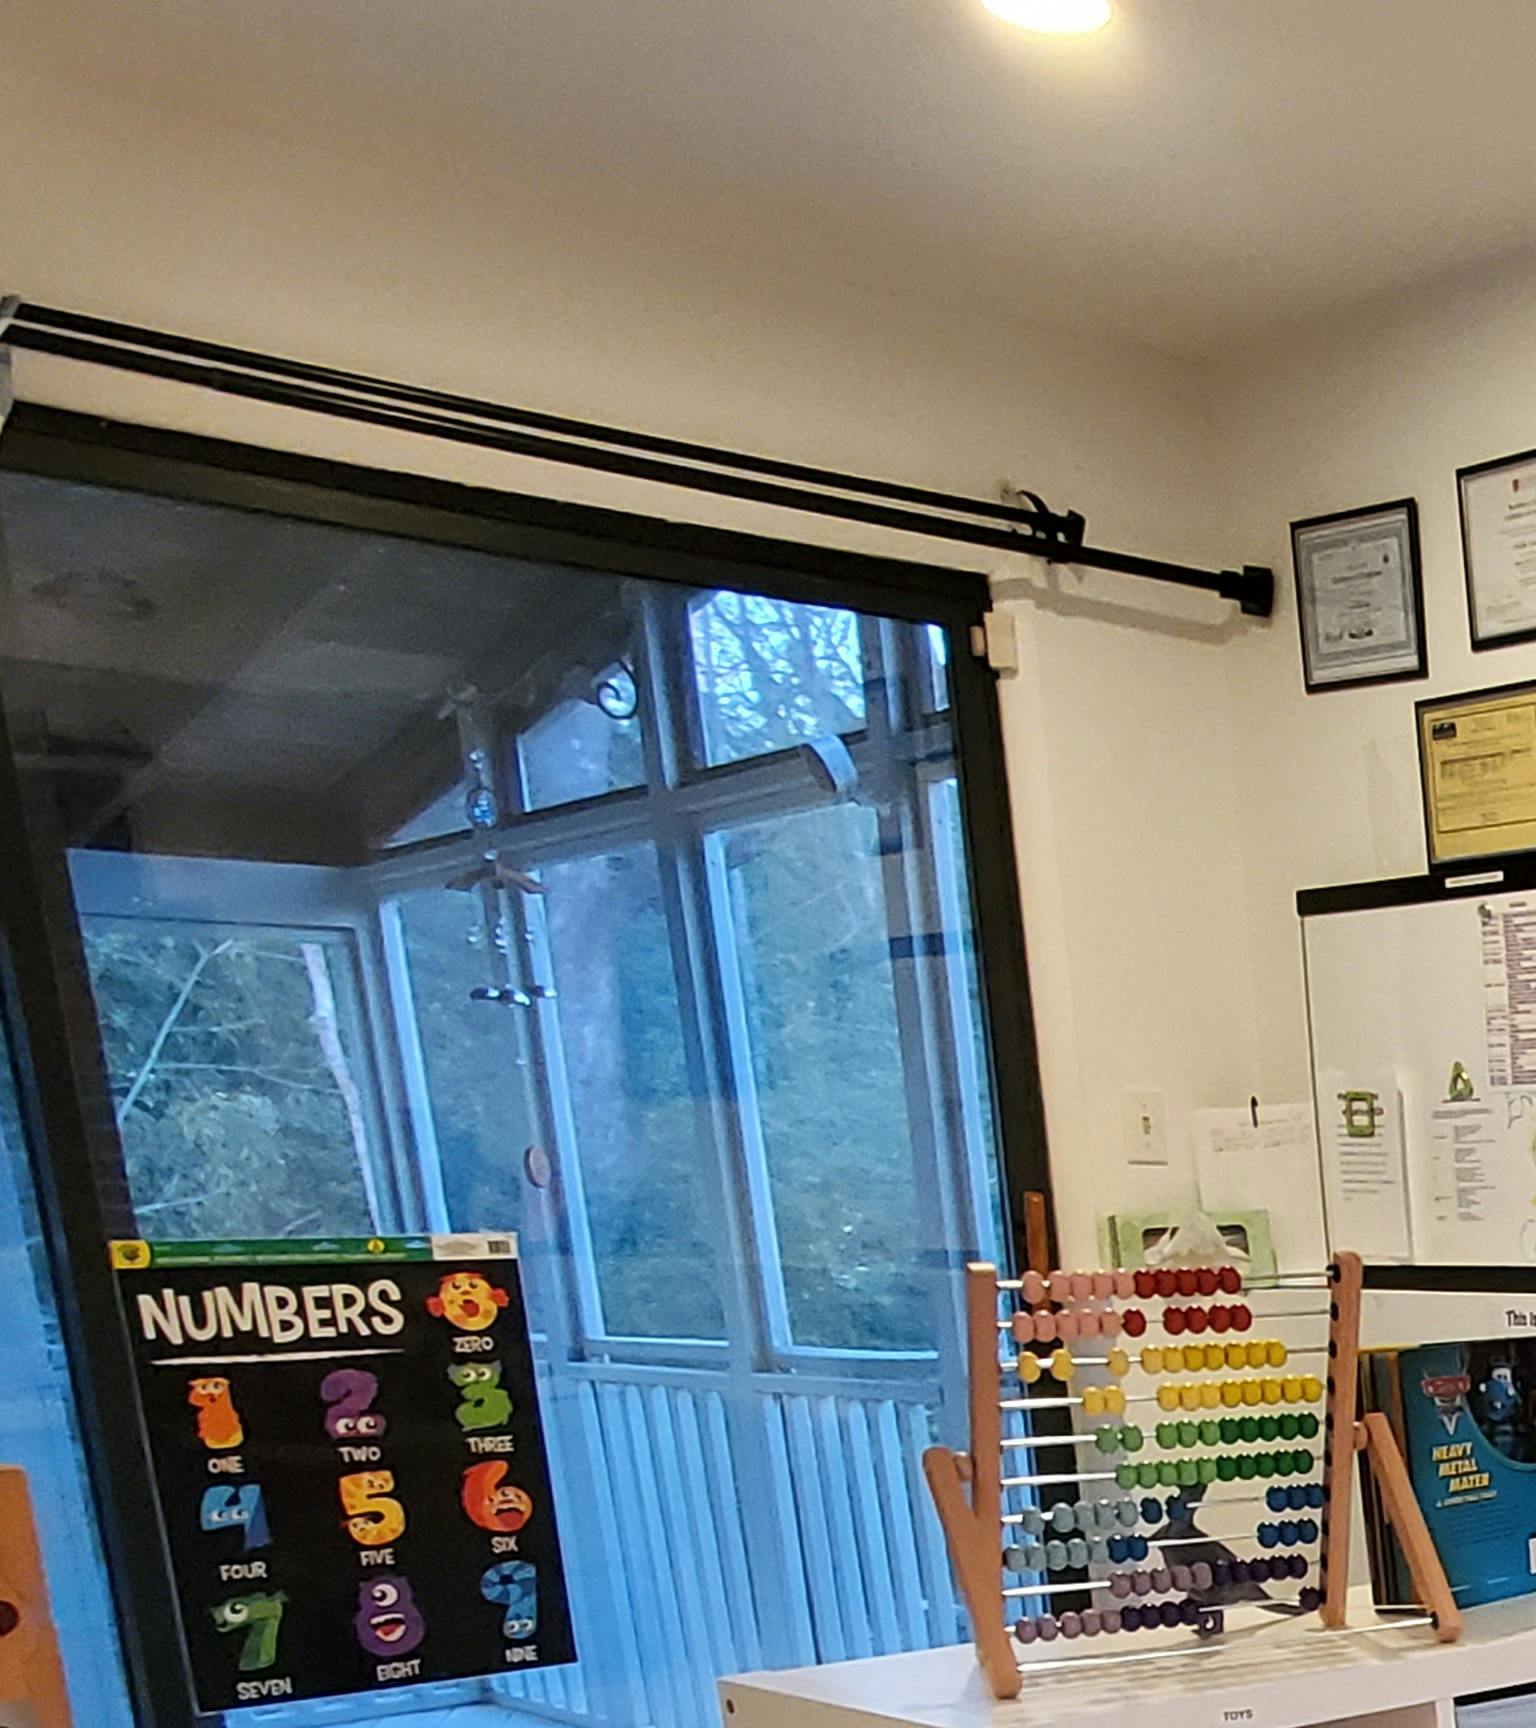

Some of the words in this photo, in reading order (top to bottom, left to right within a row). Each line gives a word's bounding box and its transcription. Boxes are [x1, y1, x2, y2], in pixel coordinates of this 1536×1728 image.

[137, 1278, 404, 1345] NUMBERS
[1506, 1310, 1527, 1327] This
[453, 1336, 493, 1353] ZERO
[466, 1434, 514, 1454] THREE
[339, 1446, 381, 1464] TWO
[208, 1456, 243, 1475] ONE
[462, 1460, 532, 1533] 6
[201, 1484, 271, 1551] 4
[339, 1470, 405, 1546] 5
[491, 1537, 518, 1554] SIX
[361, 1548, 395, 1567] FIVE
[220, 1561, 267, 1581] FOUR
[506, 1645, 538, 1663] NINE
[377, 1659, 420, 1681] EIGHT
[237, 1677, 292, 1699] SEVEN
[1223, 1709, 1253, 1720] TOYS
